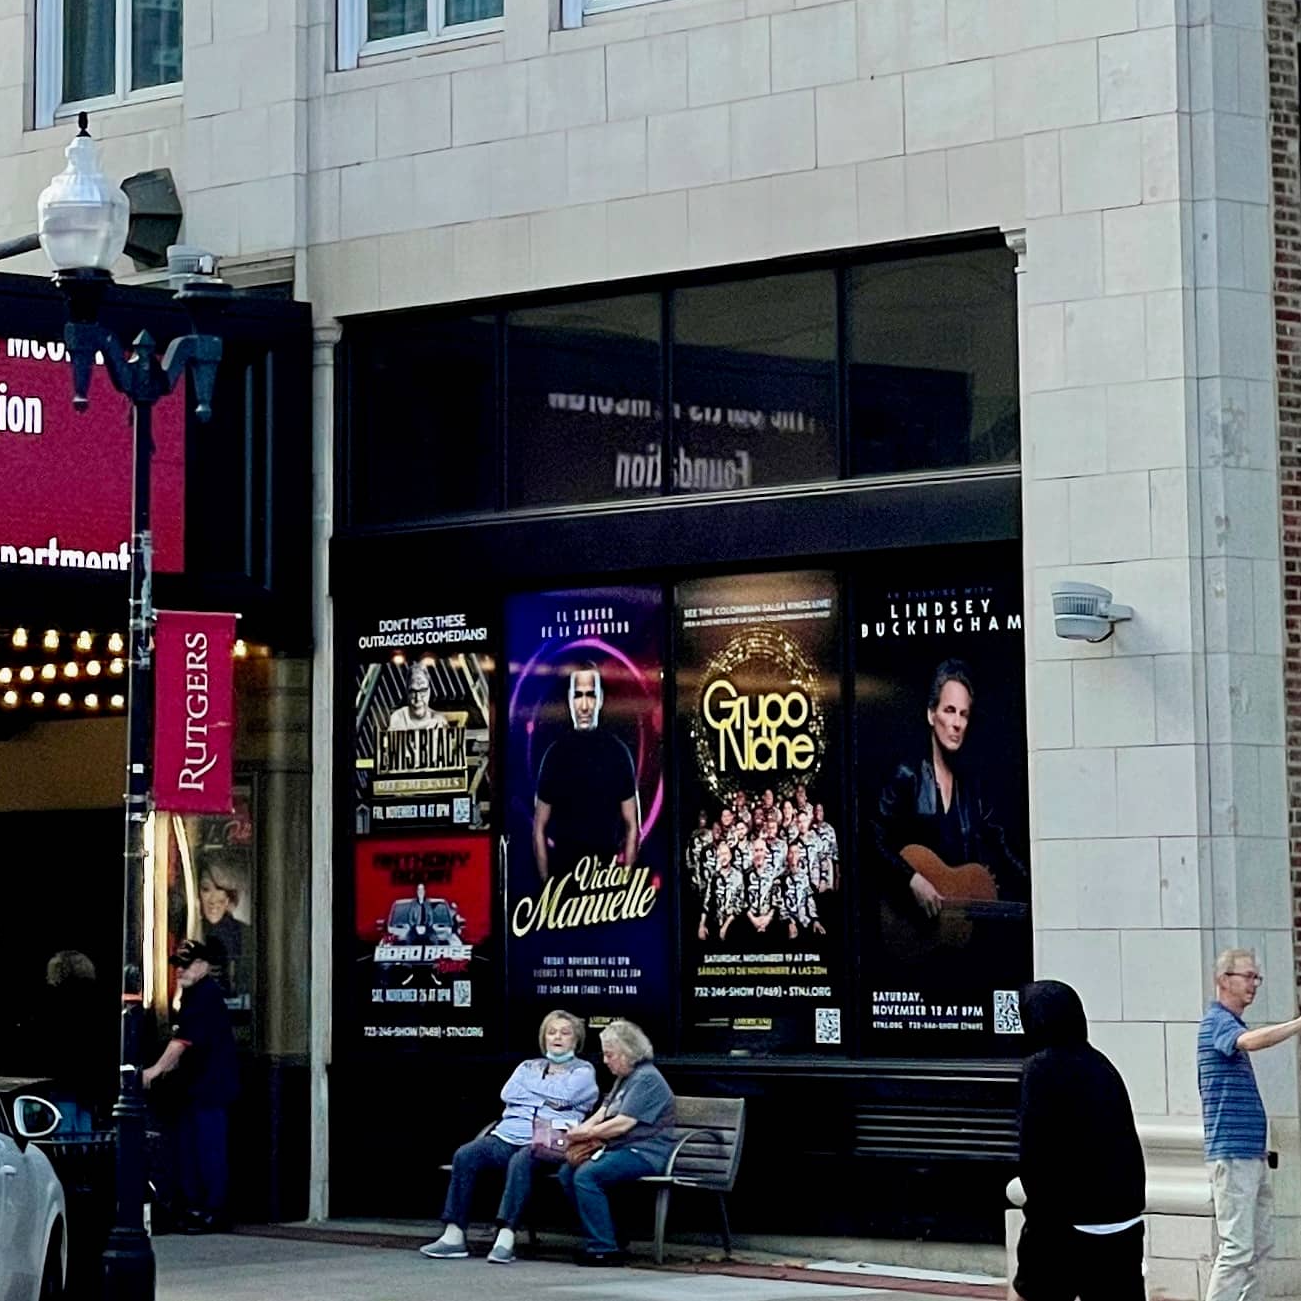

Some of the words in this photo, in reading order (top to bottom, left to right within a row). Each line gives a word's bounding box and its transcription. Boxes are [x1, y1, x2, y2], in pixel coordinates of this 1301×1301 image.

[891, 598, 990, 618] LINDSEY
[379, 618, 409, 633] DON'T
[411, 615, 434, 630] MISS
[435, 614, 466, 628] THESE
[559, 625, 570, 637] LA
[861, 614, 1022, 638] BUCKINGHAM
[359, 631, 424, 649] OUTRAGEOUS
[426, 627, 487, 644] COMEDIANS!
[178, 632, 217, 791] RUTGERS
[703, 679, 808, 736] Grupo
[375, 730, 416, 771] EWIS
[419, 727, 466, 767] BLACK
[719, 718, 815, 771] Niche
[427, 804, 435, 817] AT
[513, 867, 656, 937] Manuelle
[374, 945, 423, 962] ROAD
[424, 944, 473, 961] RAGE
[704, 954, 742, 963] SATURDAY,
[743, 953, 783, 962] NOVEMBER
[794, 953, 802, 962] AT
[737, 966, 746, 975] DE
[748, 966, 789, 975] NOVIEMBRE
[791, 966, 796, 974] A
[798, 966, 810, 975] LAS
[428, 989, 435, 1002] AT
[694, 986, 754, 997] 732-246-SHOW
[756, 986, 782, 998] (7469)
[789, 986, 831, 997] STNJ.ORG
[873, 992, 924, 1003] SATURDAY,
[873, 1005, 926, 1016] NOVEMBER
[946, 1006, 958, 1016] AT
[962, 1006, 983, 1016] 8PM
